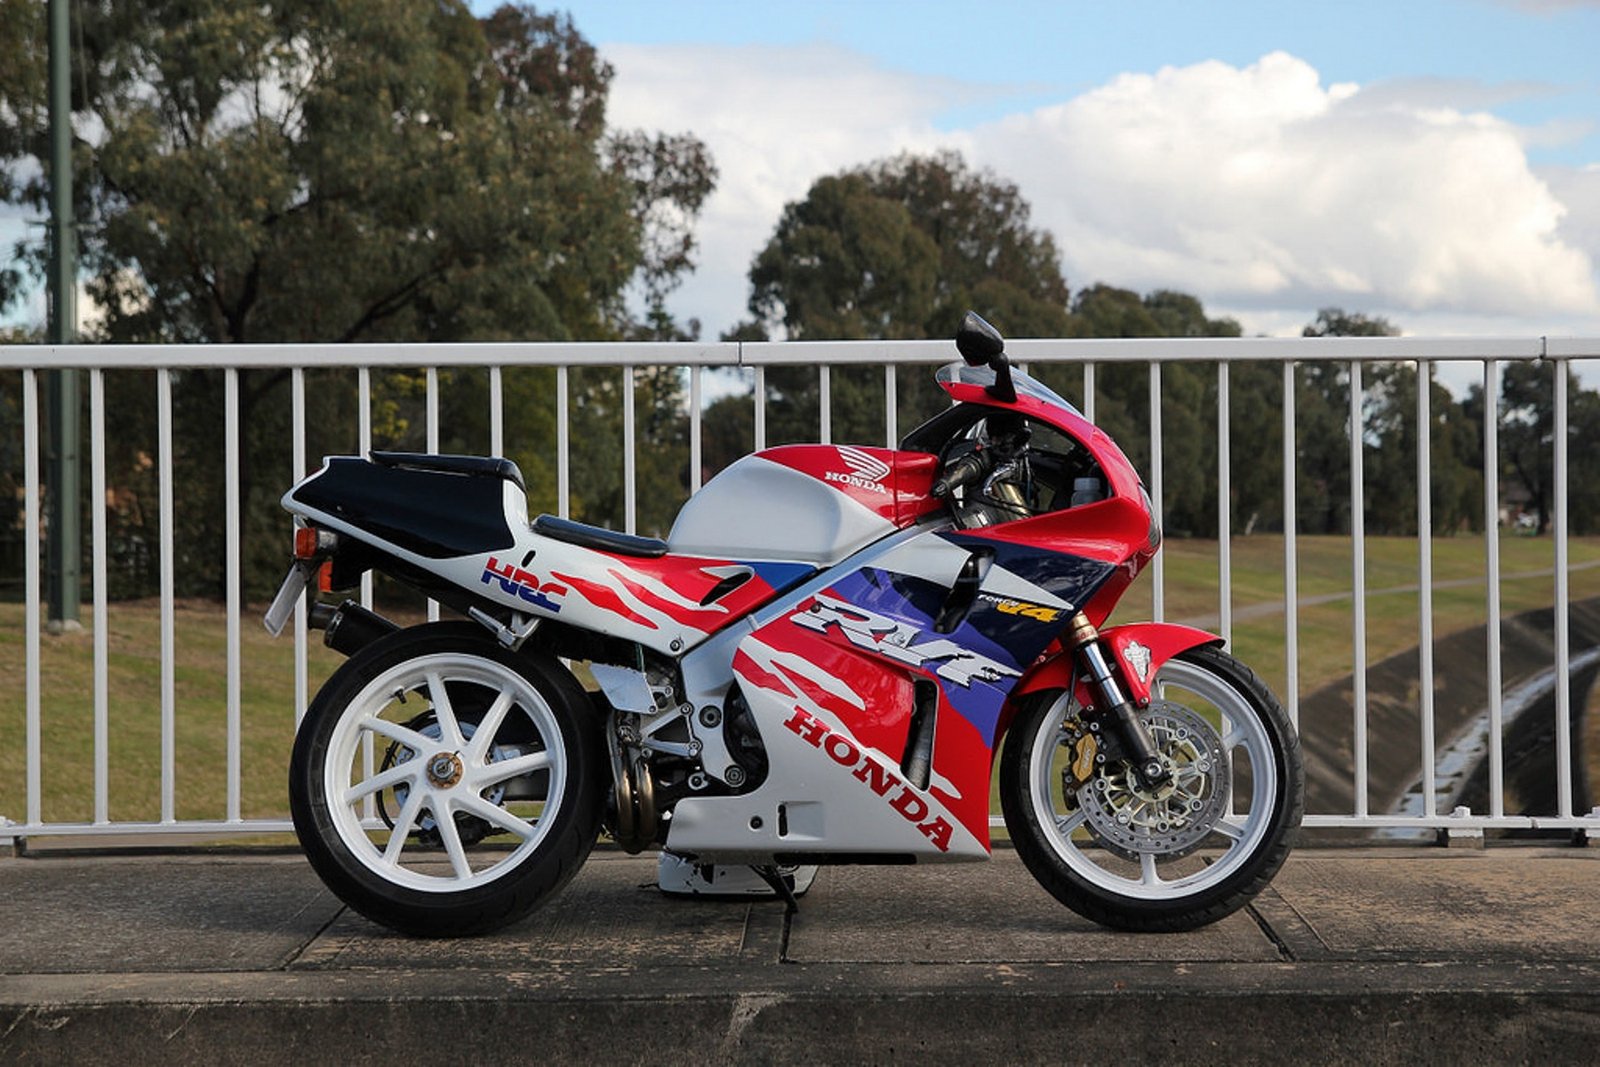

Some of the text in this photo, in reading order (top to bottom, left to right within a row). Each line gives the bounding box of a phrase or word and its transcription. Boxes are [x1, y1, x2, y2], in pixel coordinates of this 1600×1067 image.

[825, 471, 887, 494] HONDA
[481, 556, 568, 613] HRC
[783, 705, 954, 852] HONDA
